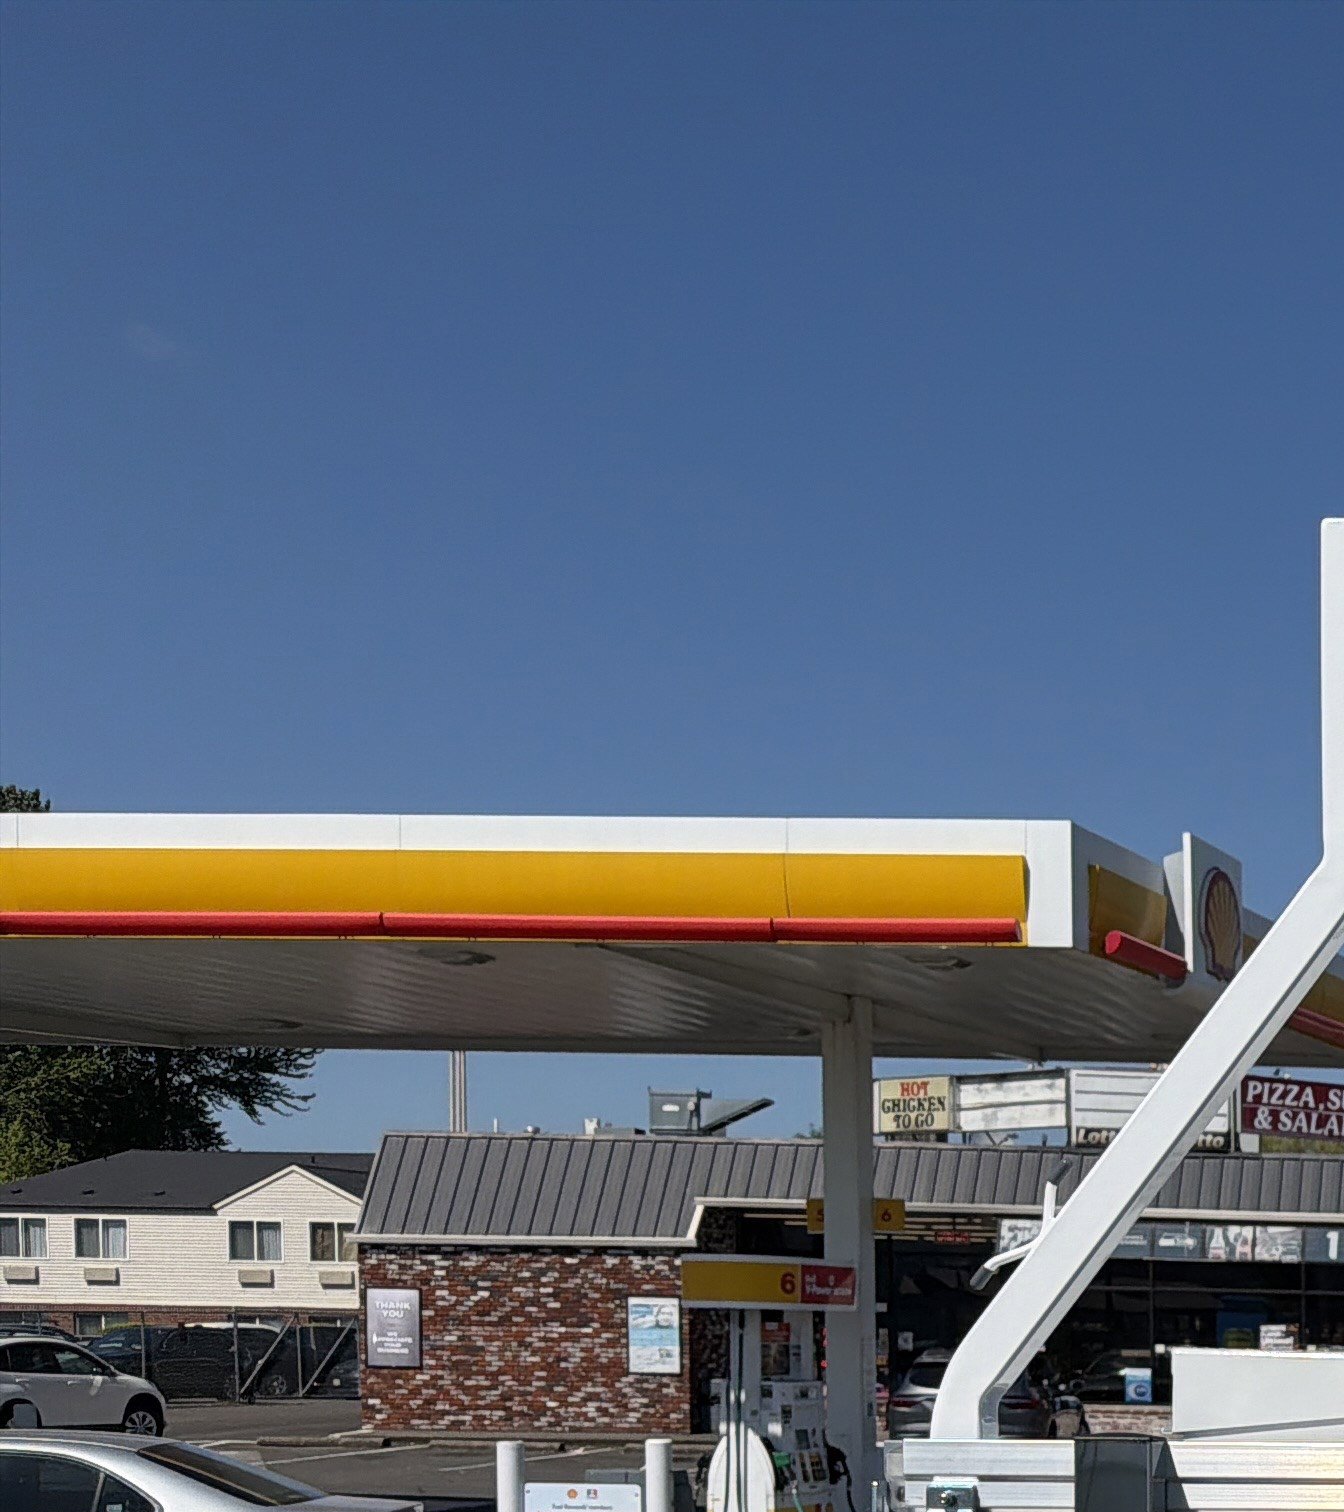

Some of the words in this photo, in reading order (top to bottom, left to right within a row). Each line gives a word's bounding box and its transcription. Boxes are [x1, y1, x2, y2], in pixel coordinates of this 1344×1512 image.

[901, 1081, 929, 1098] HOT
[881, 1095, 947, 1114] CHICKEN
[893, 1113, 913, 1130] TO
[914, 1112, 936, 1129] GO
[1253, 1106, 1274, 1130] &
[1078, 1128, 1116, 1144] Lott
[881, 1208, 893, 1223] 6
[780, 1271, 797, 1296] 6
[374, 1300, 411, 1311] THANK
[382, 1309, 404, 1318] YOU
